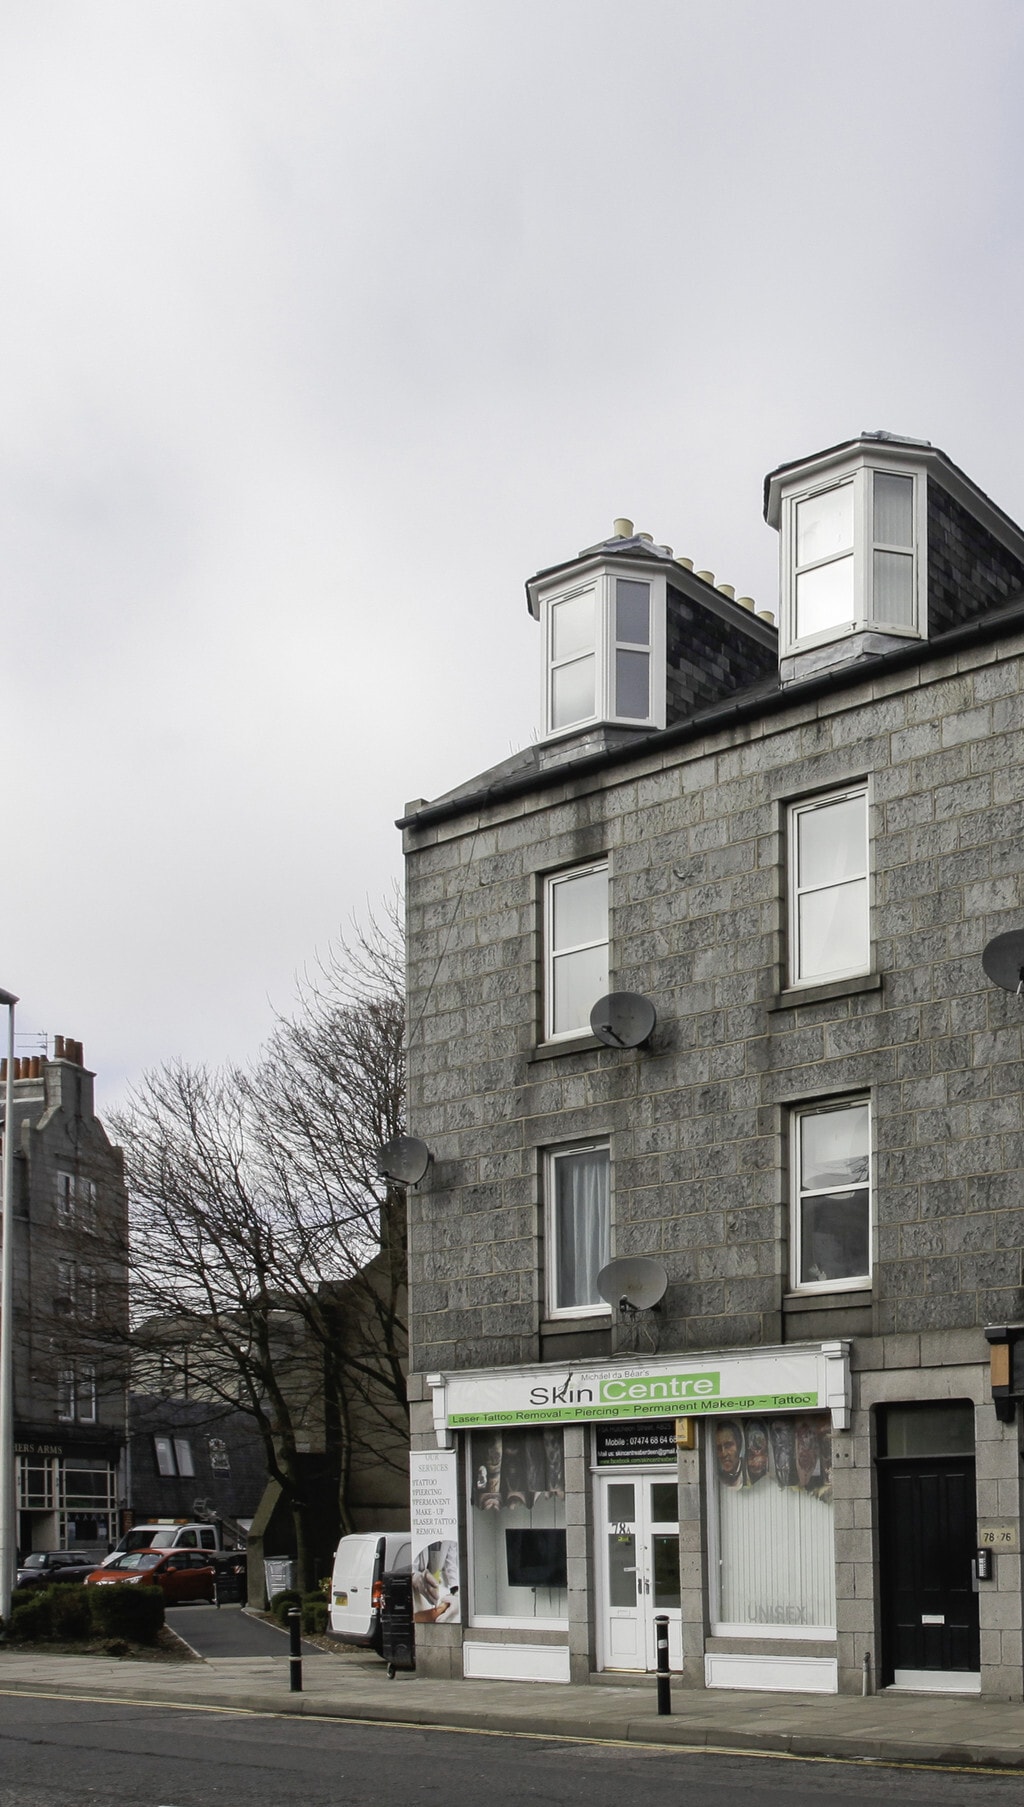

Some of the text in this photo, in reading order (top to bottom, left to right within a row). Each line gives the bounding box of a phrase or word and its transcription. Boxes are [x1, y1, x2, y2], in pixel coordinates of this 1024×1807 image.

[529, 1377, 714, 1406] Skin Centre
[452, 1415, 480, 1424] Laser
[483, 1413, 513, 1422] Tattoo
[516, 1411, 562, 1420] Removal
[575, 1407, 619, 1417] Piercing
[633, 1402, 697, 1413] Permanent
[701, 1399, 755, 1410] Make-up
[771, 1395, 811, 1405] Tattoo
[605, 1438, 625, 1446] Mobile
[37, 1444, 63, 1455] ARMS
[418, 1464, 449, 1473] SERVICES
[415, 1498, 450, 1506] PERMANENT
[416, 1508, 432, 1516] MAKE
[416, 1517, 457, 1526] LASER TATTOO
[983, 1532, 1011, 1542] 78 76
[747, 1604, 806, 1621] UNISEX
